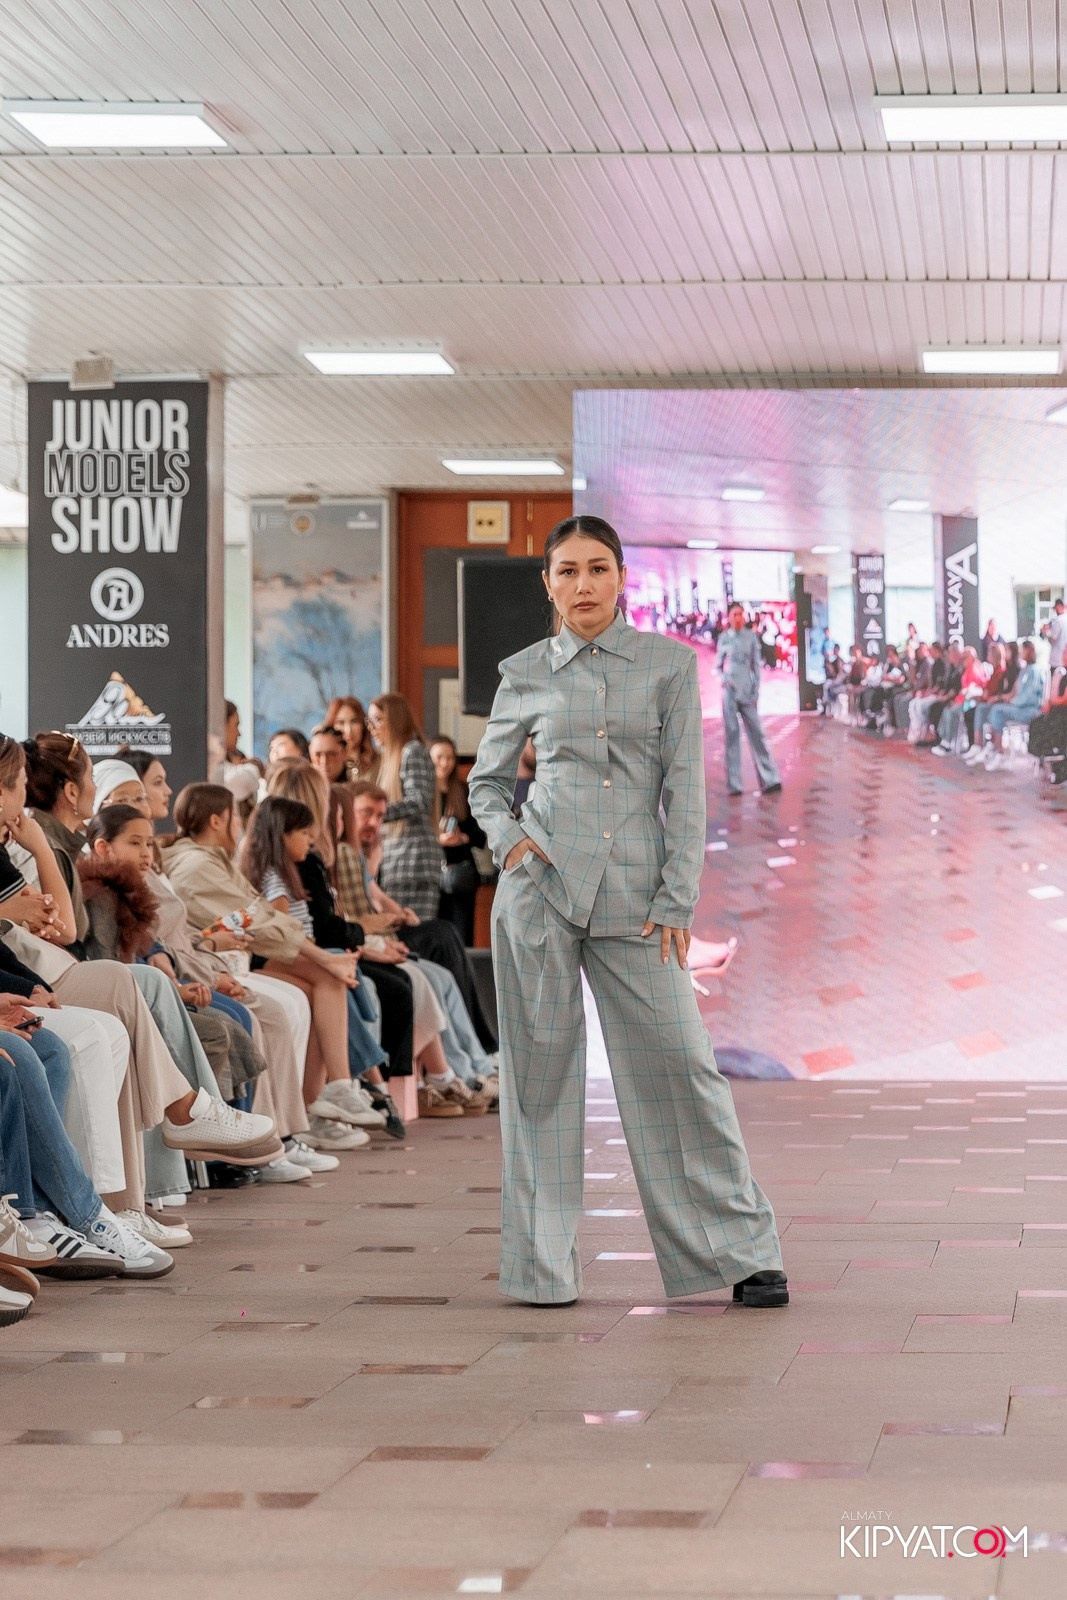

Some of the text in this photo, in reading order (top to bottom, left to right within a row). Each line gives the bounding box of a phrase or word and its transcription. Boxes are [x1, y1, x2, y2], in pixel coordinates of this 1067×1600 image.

[45, 399, 189, 451] JUNIOR
[44, 449, 190, 497] MODELS
[51, 497, 183, 553] SHOW
[66, 623, 170, 648] ANDRES
